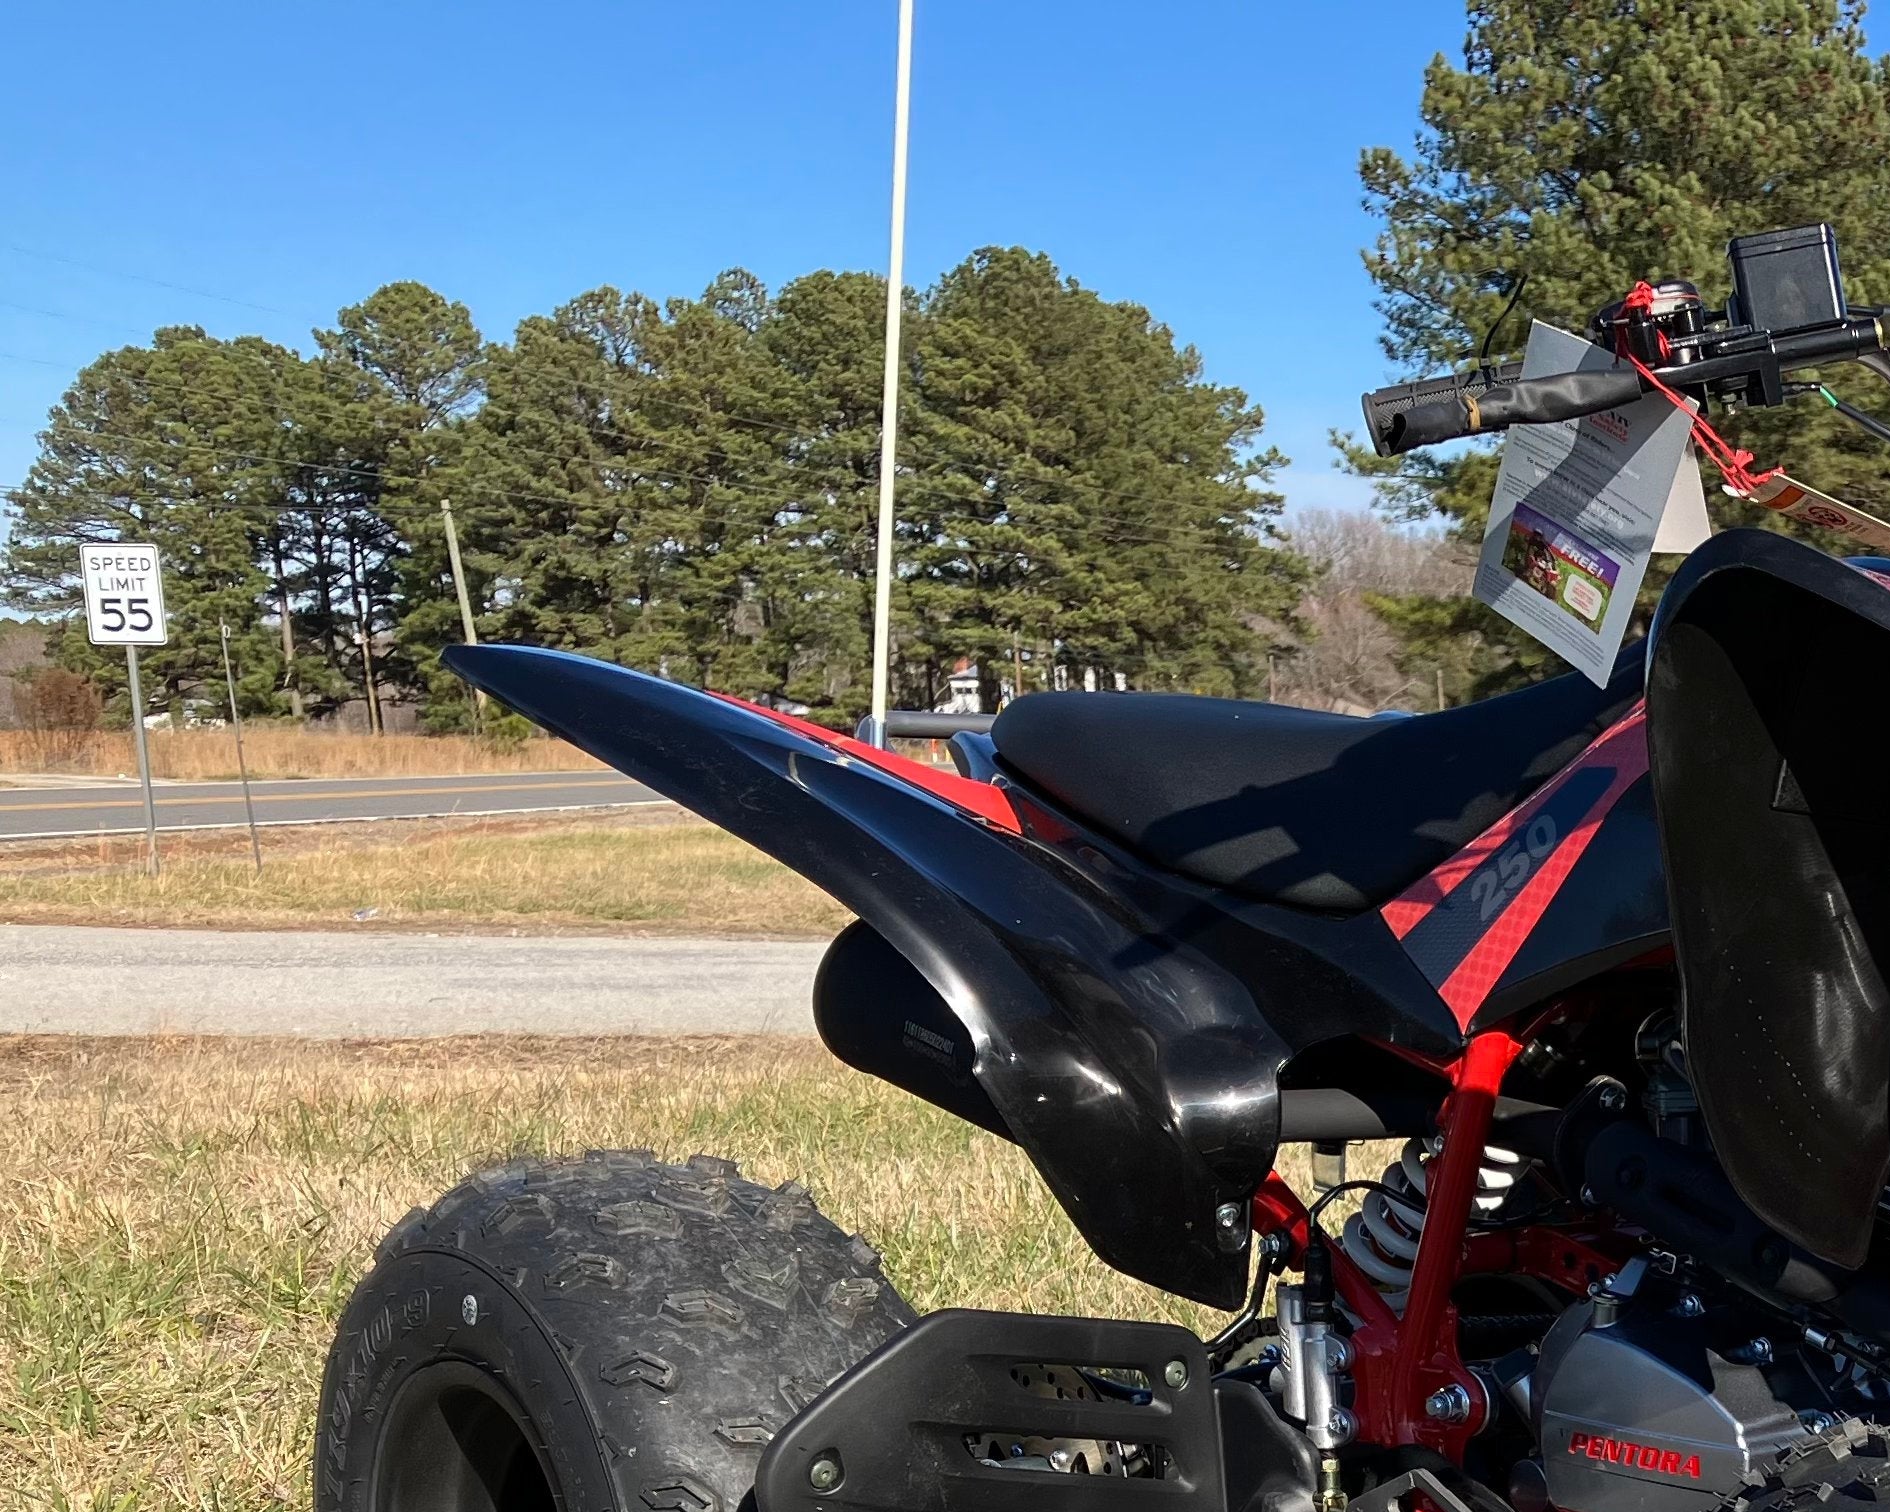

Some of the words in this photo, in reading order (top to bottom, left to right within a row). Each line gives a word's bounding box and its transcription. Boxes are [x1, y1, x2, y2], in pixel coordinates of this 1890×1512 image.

[90, 557, 151, 572] SPEED
[1560, 545, 1604, 578] FREE!
[98, 577, 145, 592] LIMIT
[101, 598, 153, 632] 55
[1470, 814, 1557, 922] 250
[1568, 1431, 1701, 1479] PENTORA
